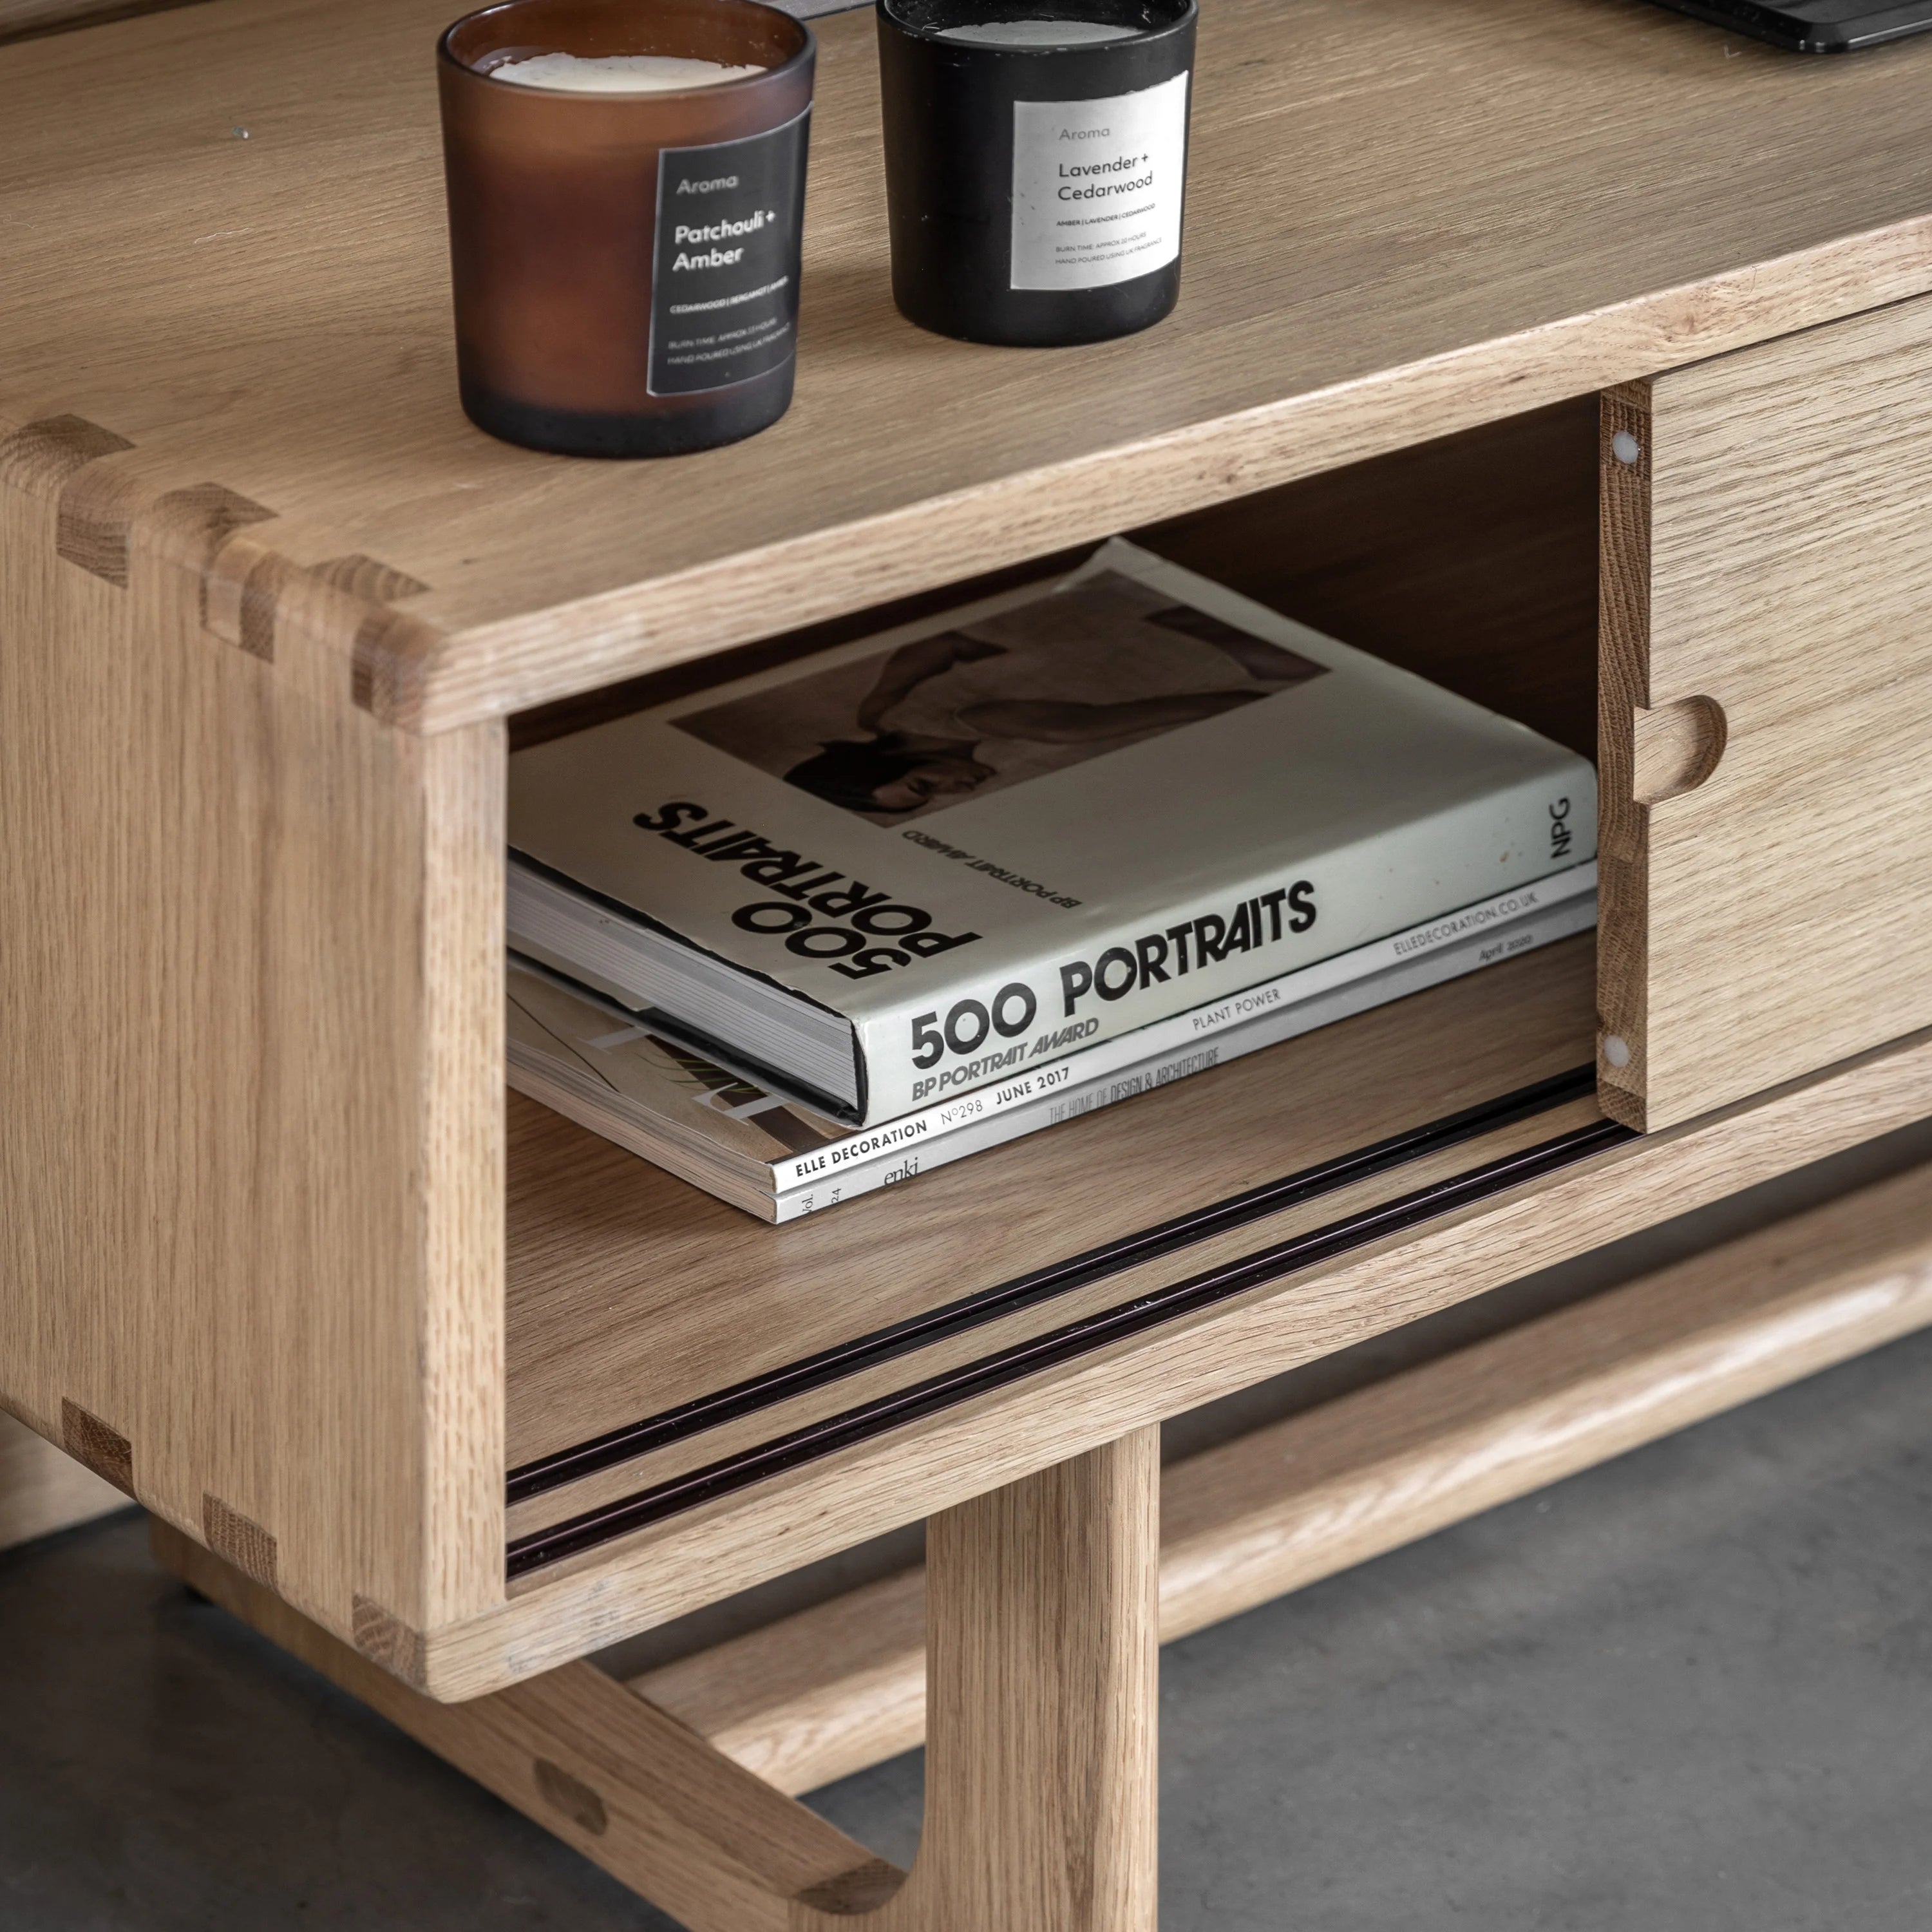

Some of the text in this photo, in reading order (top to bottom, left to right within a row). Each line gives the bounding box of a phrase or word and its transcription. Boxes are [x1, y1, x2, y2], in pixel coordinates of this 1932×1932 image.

[1058, 128, 1110, 140] Aroma
[1059, 156, 1137, 177] Lavender
[676, 176, 739, 194] Aroma
[1057, 171, 1153, 200] Cedarwood
[1084, 214, 1118, 225] LAVENDER
[1121, 203, 1155, 218] CEDARWOOD
[1077, 254, 1105, 263] POURED
[1106, 251, 1125, 259] USING
[1095, 240, 1119, 249] APPROX
[672, 247, 744, 272] Amber
[670, 298, 726, 314] CEDARWOOD
[1549, 796, 1572, 860] NPG
[632, 801, 983, 958] PORTRAITS
[902, 830, 1083, 909] BP PORTRAIT AWARD
[731, 902, 912, 980] 500
[911, 880, 1317, 1070] 500 PORTRAITS
[1049, 1103, 1065, 1124] THE
[1068, 1093, 1094, 1117] HOME
[1097, 1088, 1107, 1109] OF
[1110, 1075, 1142, 1103] DESIGN
[1145, 1072, 1153, 1090] &
[1155, 1047, 1219, 1086] ARCHITECTURE
[1479, 942, 1502, 961] April
[911, 1017, 1099, 1102] BP PORTRAIT AWARD
[795, 1156, 826, 1177] ELLE
[832, 1119, 927, 1164] DECORATION
[996, 1080, 1032, 1106] JUNE
[1038, 1066, 1070, 1090] 2017
[1193, 1006, 1231, 1031] PLANT
[1235, 988, 1282, 1015] POWER
[884, 1157, 918, 1184] enki
